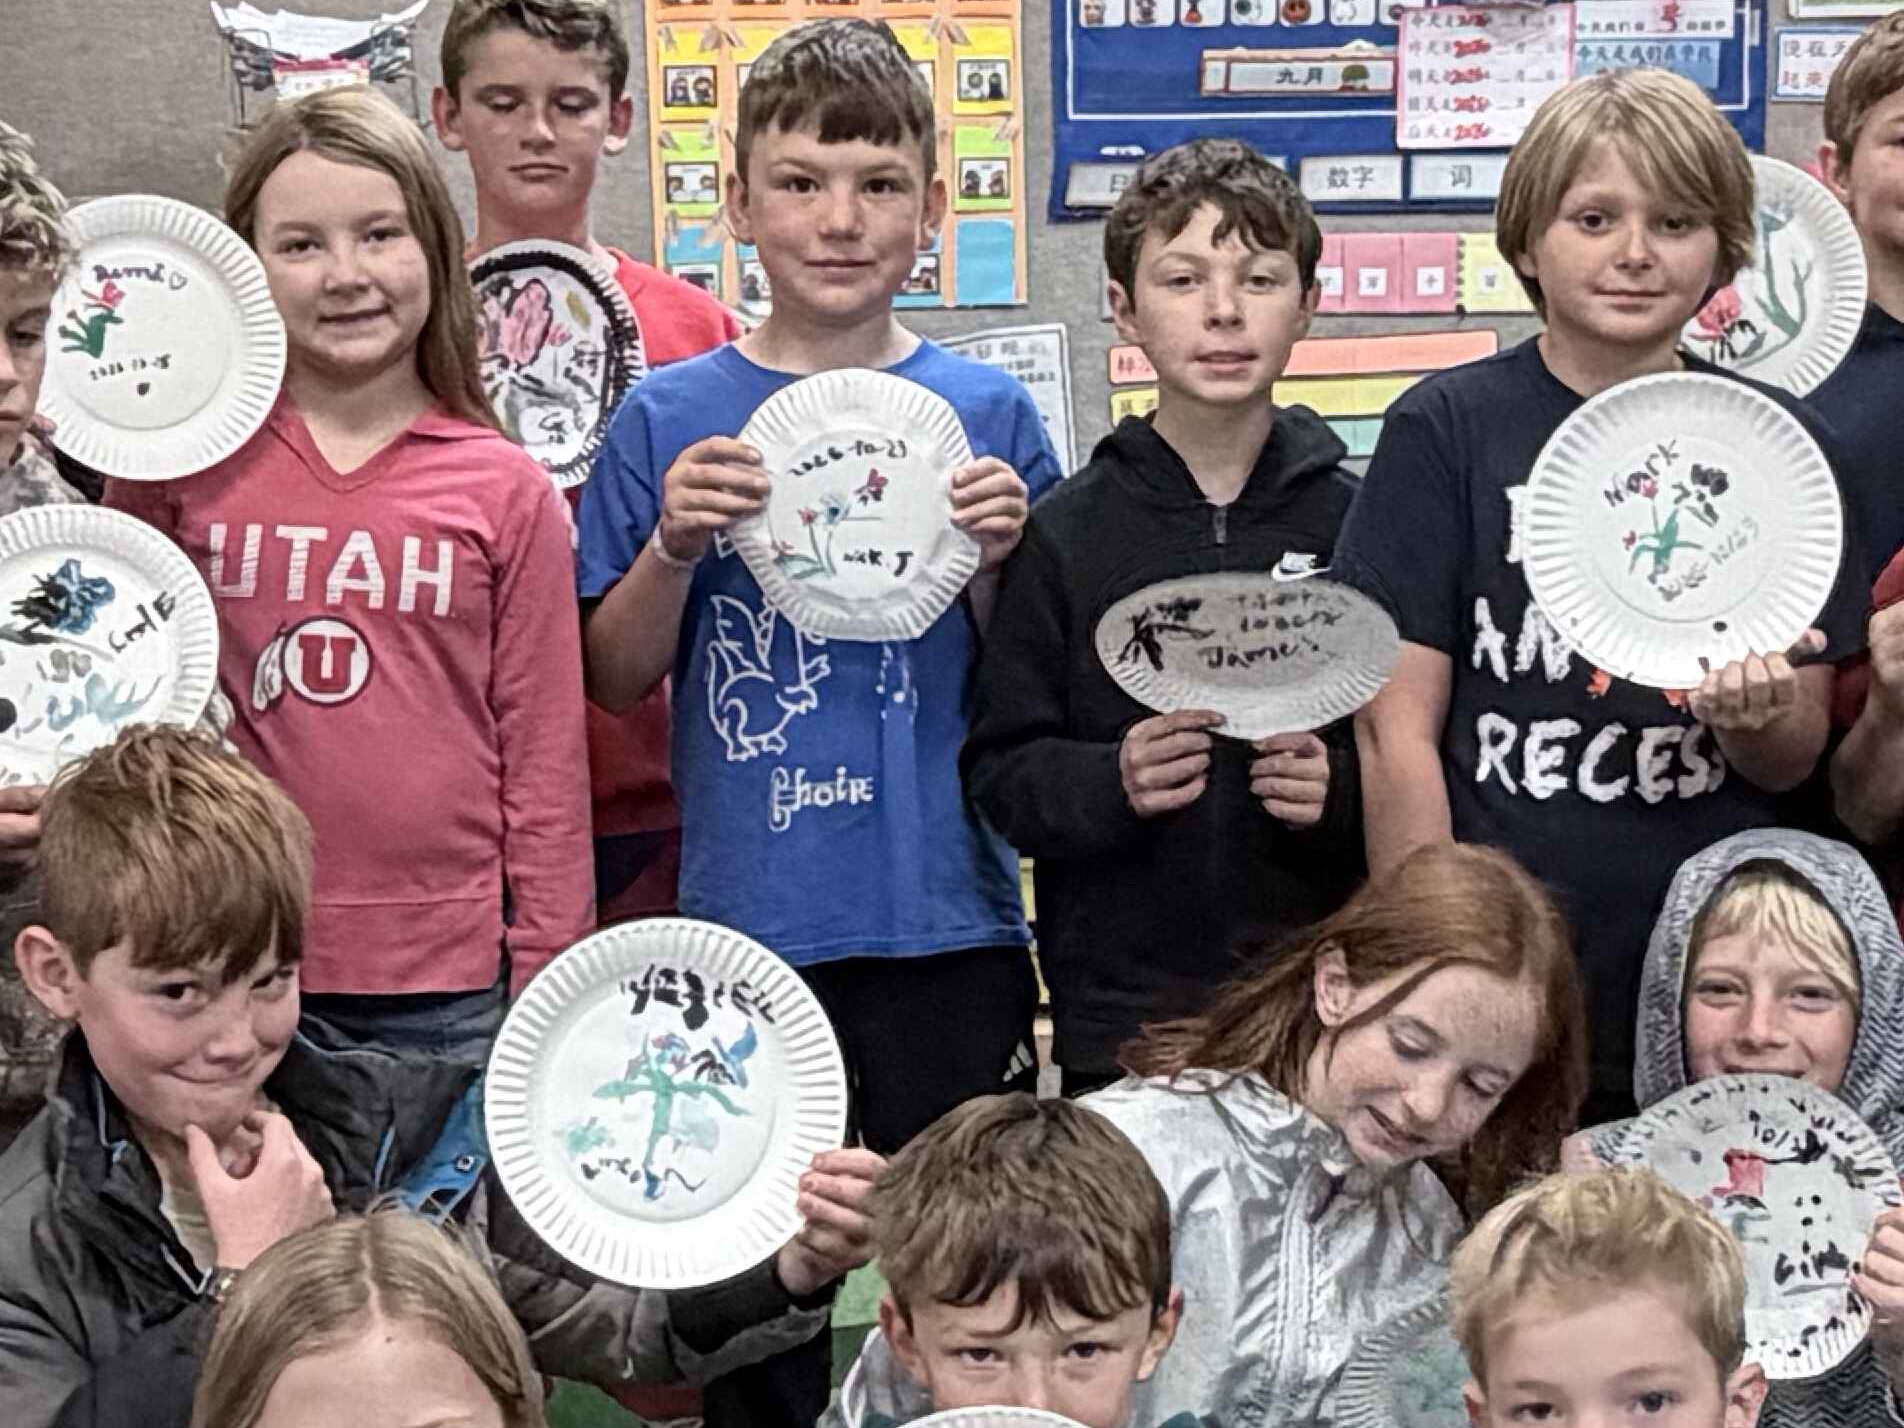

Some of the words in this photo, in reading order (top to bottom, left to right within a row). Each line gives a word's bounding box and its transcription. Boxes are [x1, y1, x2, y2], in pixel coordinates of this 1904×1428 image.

[1326, 165, 1375, 190] 数字
[207, 521, 457, 618] UTAH
[296, 633, 359, 680] U
